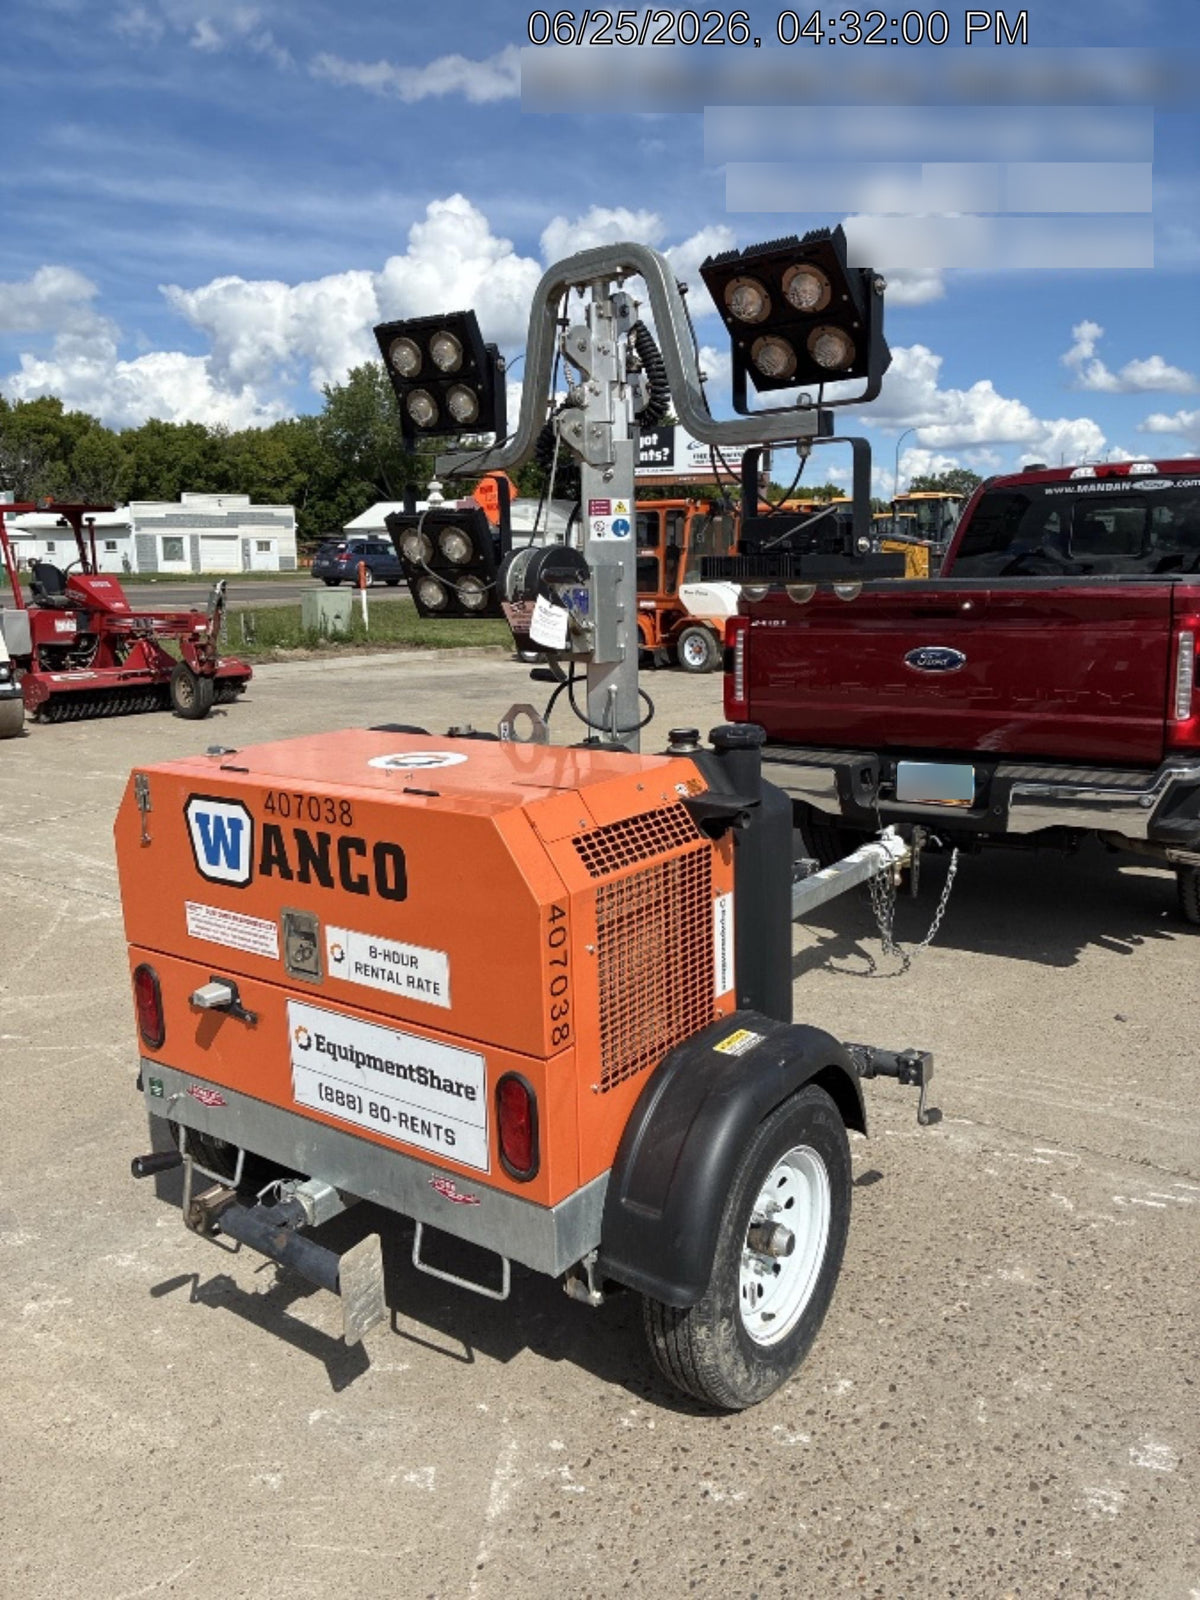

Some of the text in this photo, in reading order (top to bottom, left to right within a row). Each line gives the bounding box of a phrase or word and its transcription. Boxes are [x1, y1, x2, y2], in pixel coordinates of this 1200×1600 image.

[264, 791, 353, 826] 407038
[194, 811, 408, 902] WANCO
[354, 961, 441, 996] RENTAL RATE
[549, 905, 570, 1046] 407038
[314, 1032, 477, 1101] EquipmentShare
[318, 1082, 456, 1146] (888) 80-RENTS
